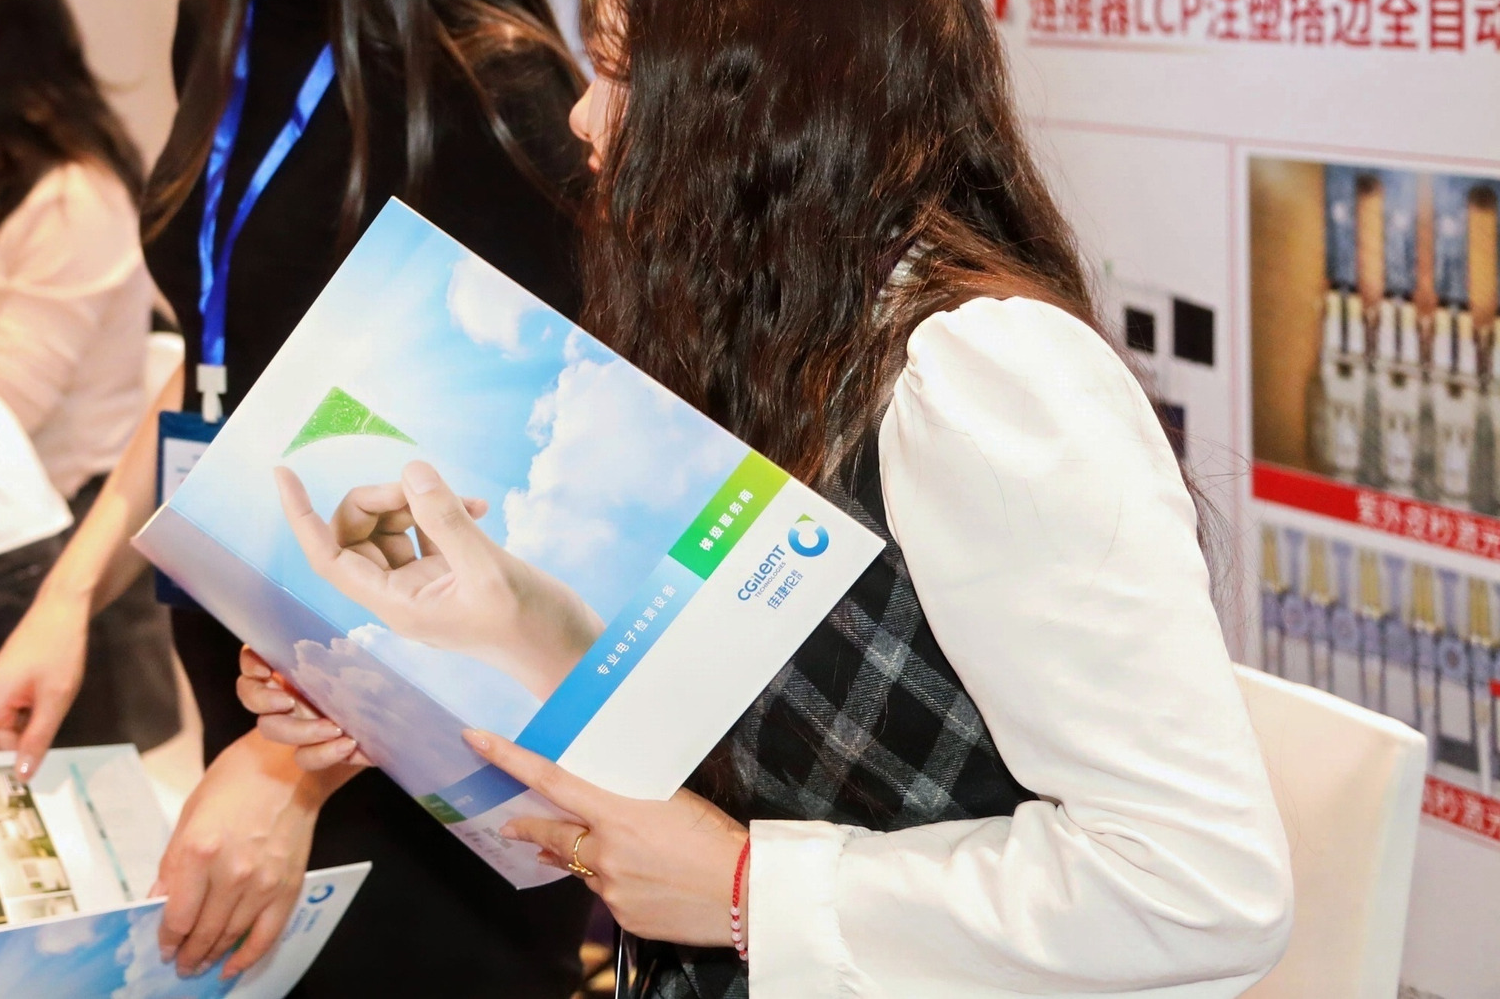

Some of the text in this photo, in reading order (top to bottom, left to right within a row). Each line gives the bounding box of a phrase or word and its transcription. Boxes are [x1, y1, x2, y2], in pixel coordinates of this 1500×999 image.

[754, 561, 787, 599] TECHNOLOGIES
[596, 584, 677, 677] 专业电子检测设备
